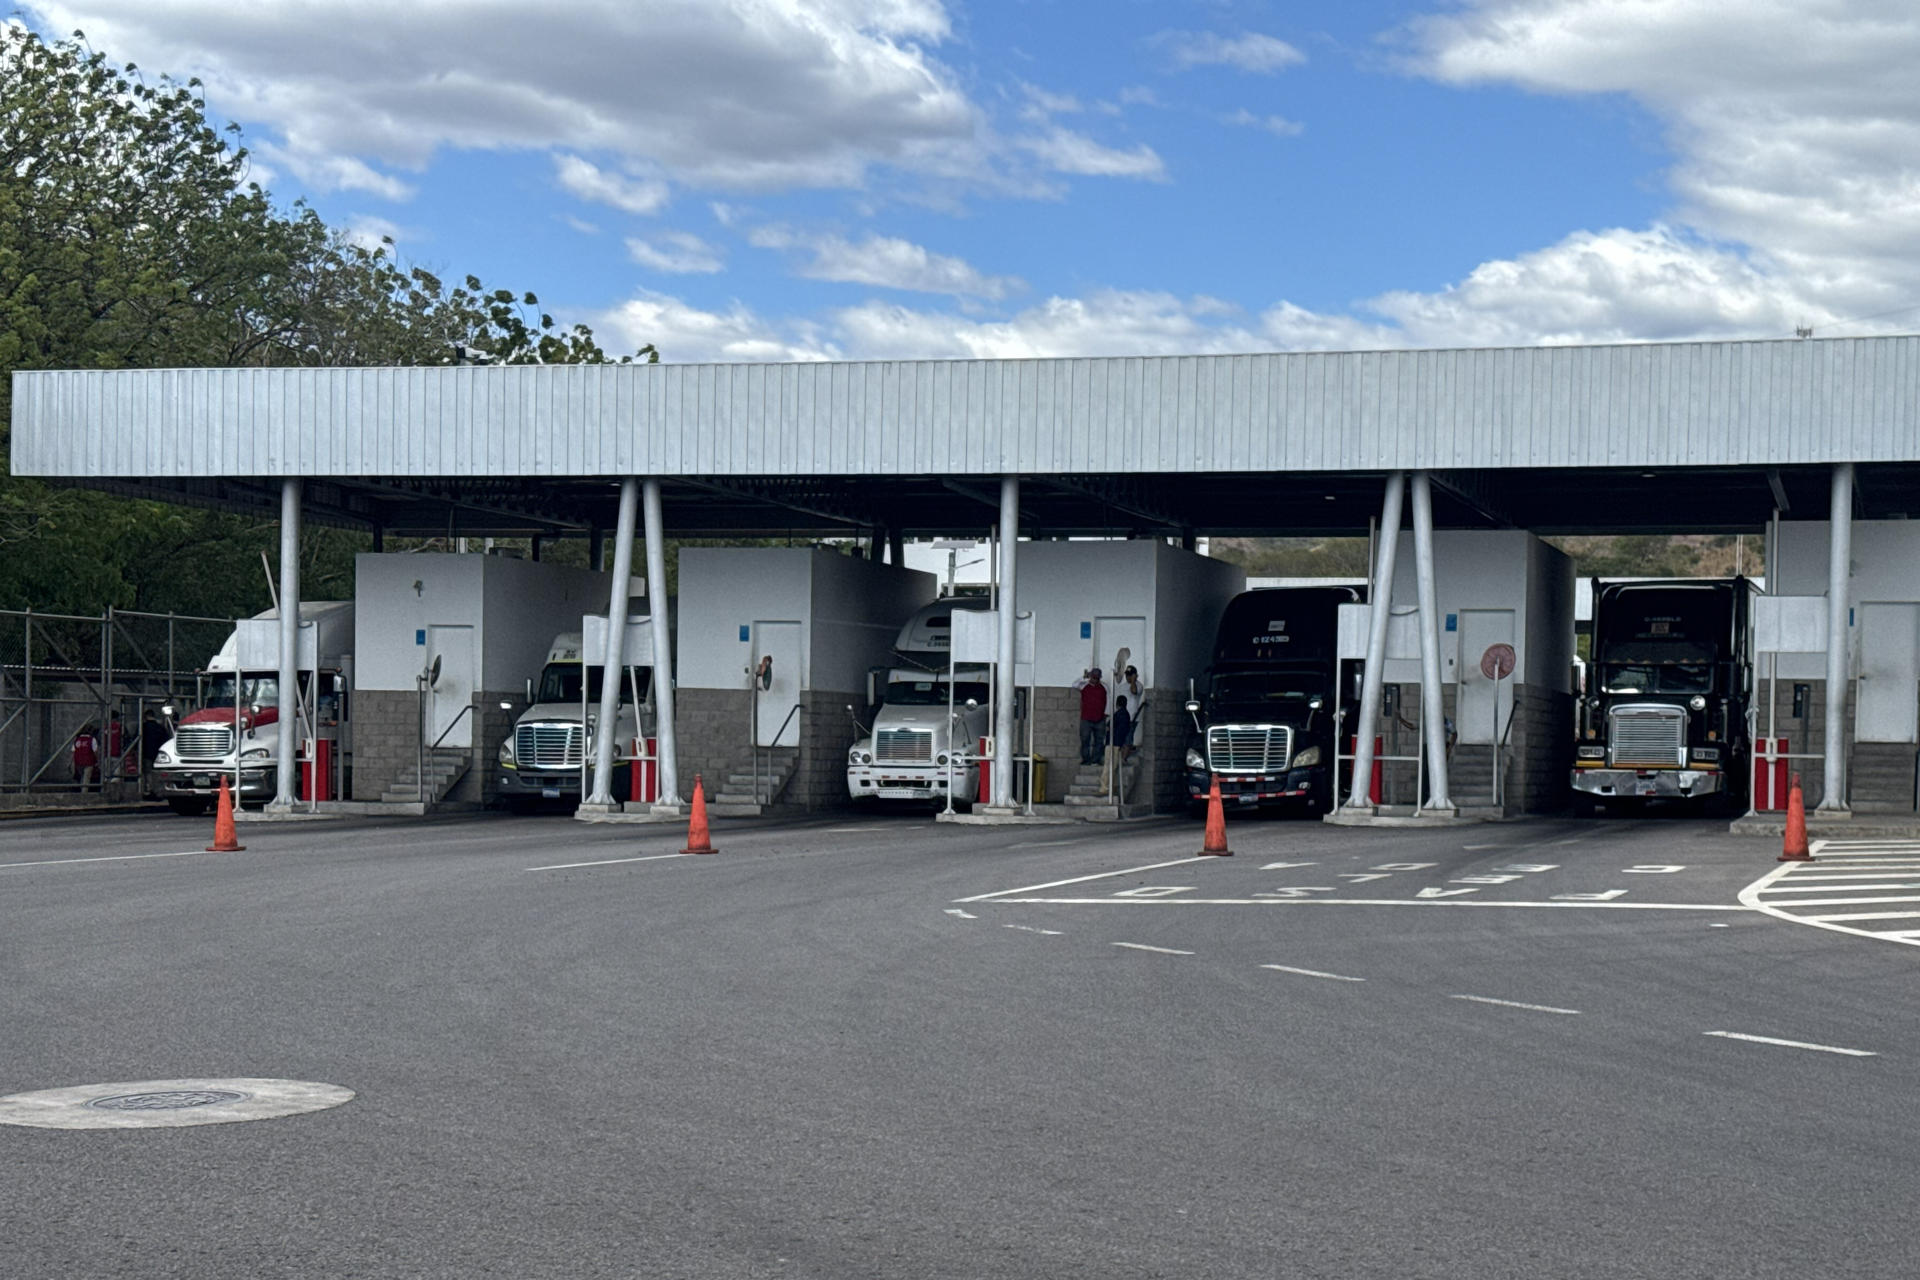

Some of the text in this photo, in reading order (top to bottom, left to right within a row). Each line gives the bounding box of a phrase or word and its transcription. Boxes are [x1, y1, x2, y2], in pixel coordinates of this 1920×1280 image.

[1258, 862, 1687, 874] CEDA
[1337, 873, 1525, 884] EL
[1112, 886, 1629, 901] PASO
